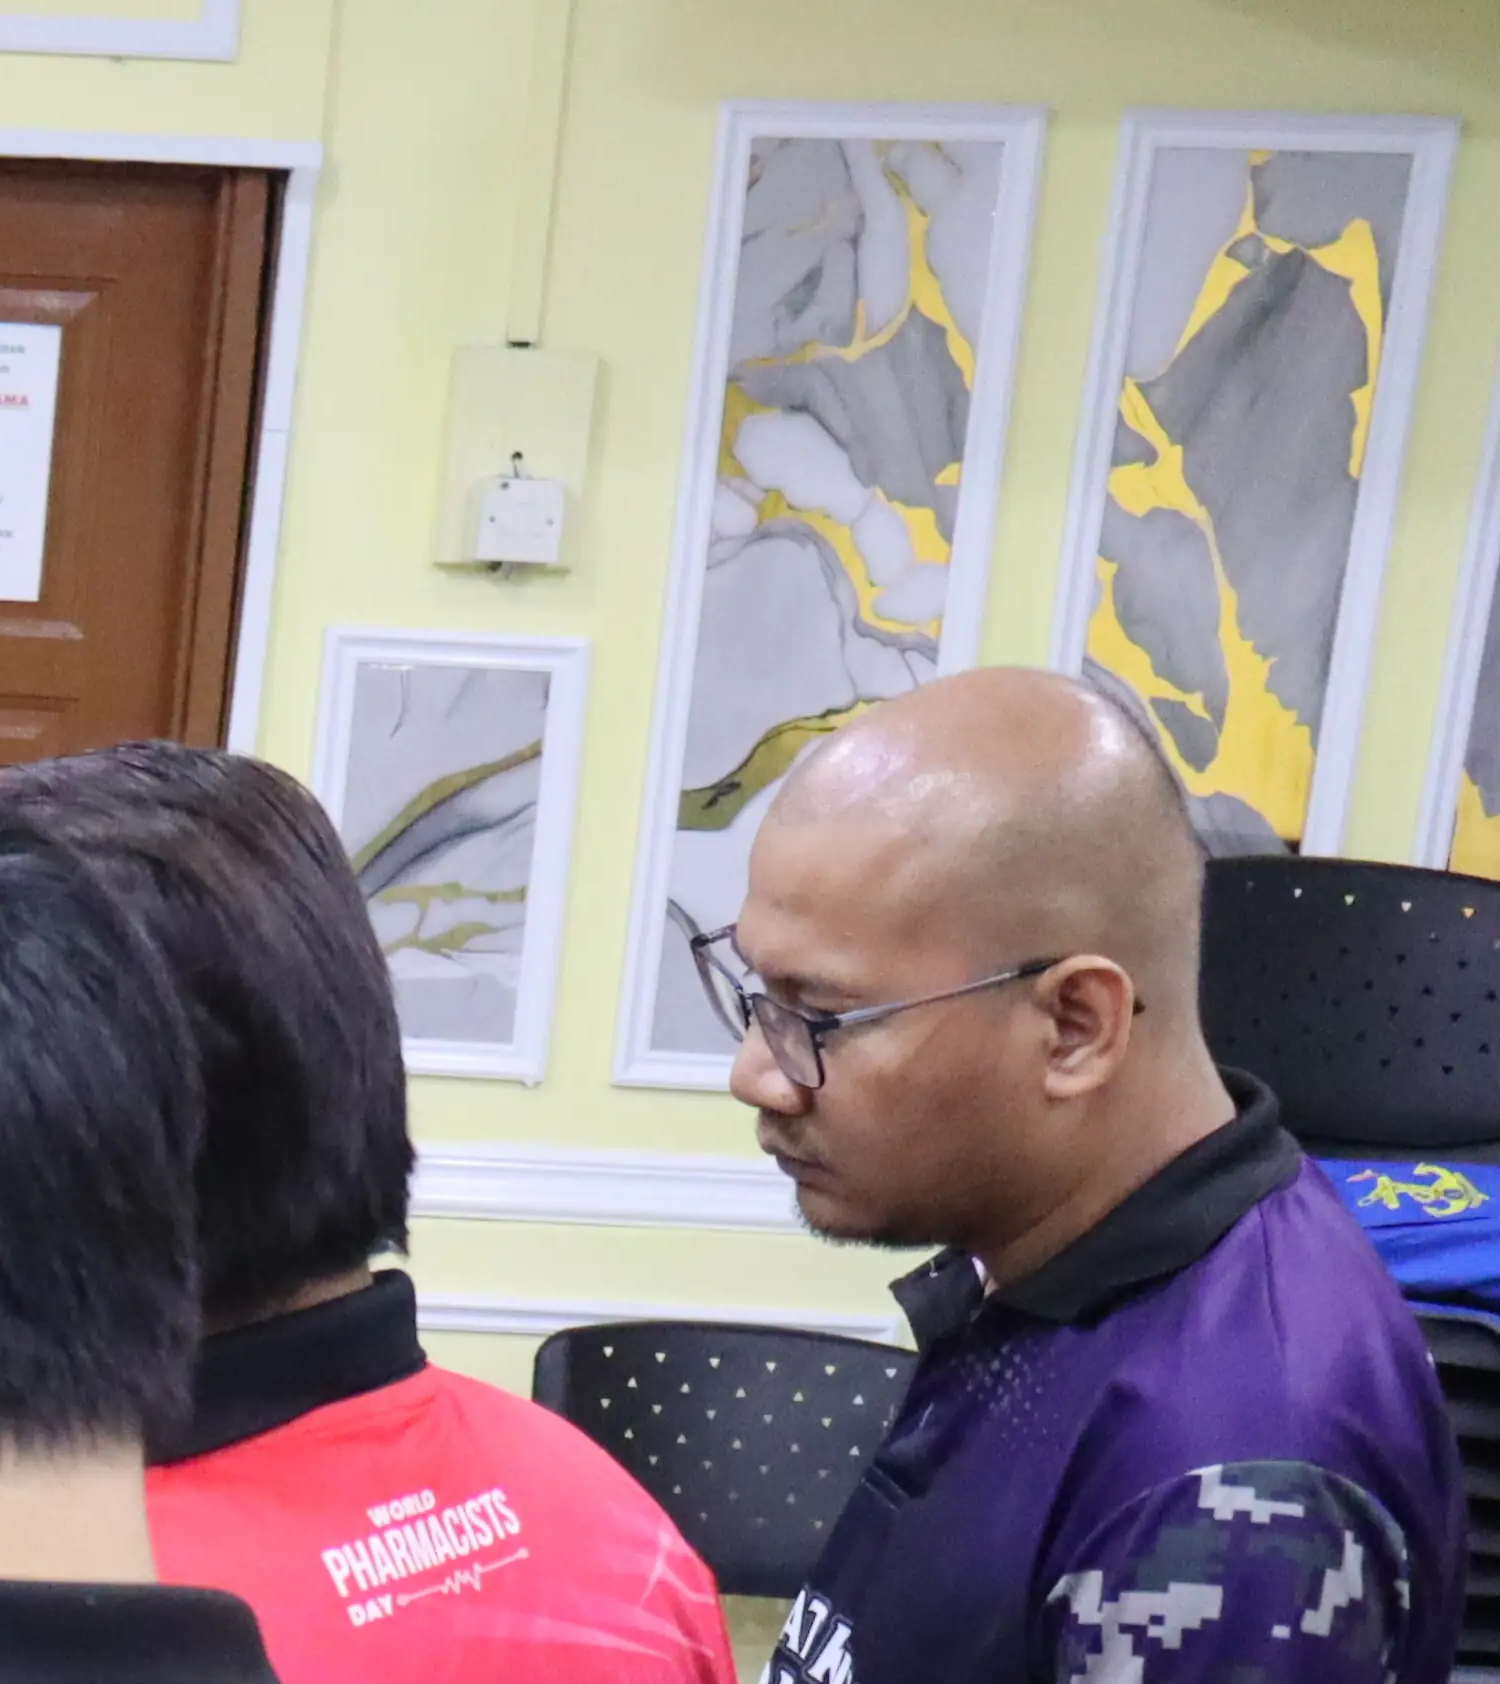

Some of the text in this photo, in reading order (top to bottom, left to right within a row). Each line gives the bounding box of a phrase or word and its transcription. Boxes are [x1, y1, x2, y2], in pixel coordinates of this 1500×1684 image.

[366, 1489, 436, 1528] WORLD
[320, 1487, 521, 1599] PHARMACISTS
[347, 1593, 393, 1627] DAY
